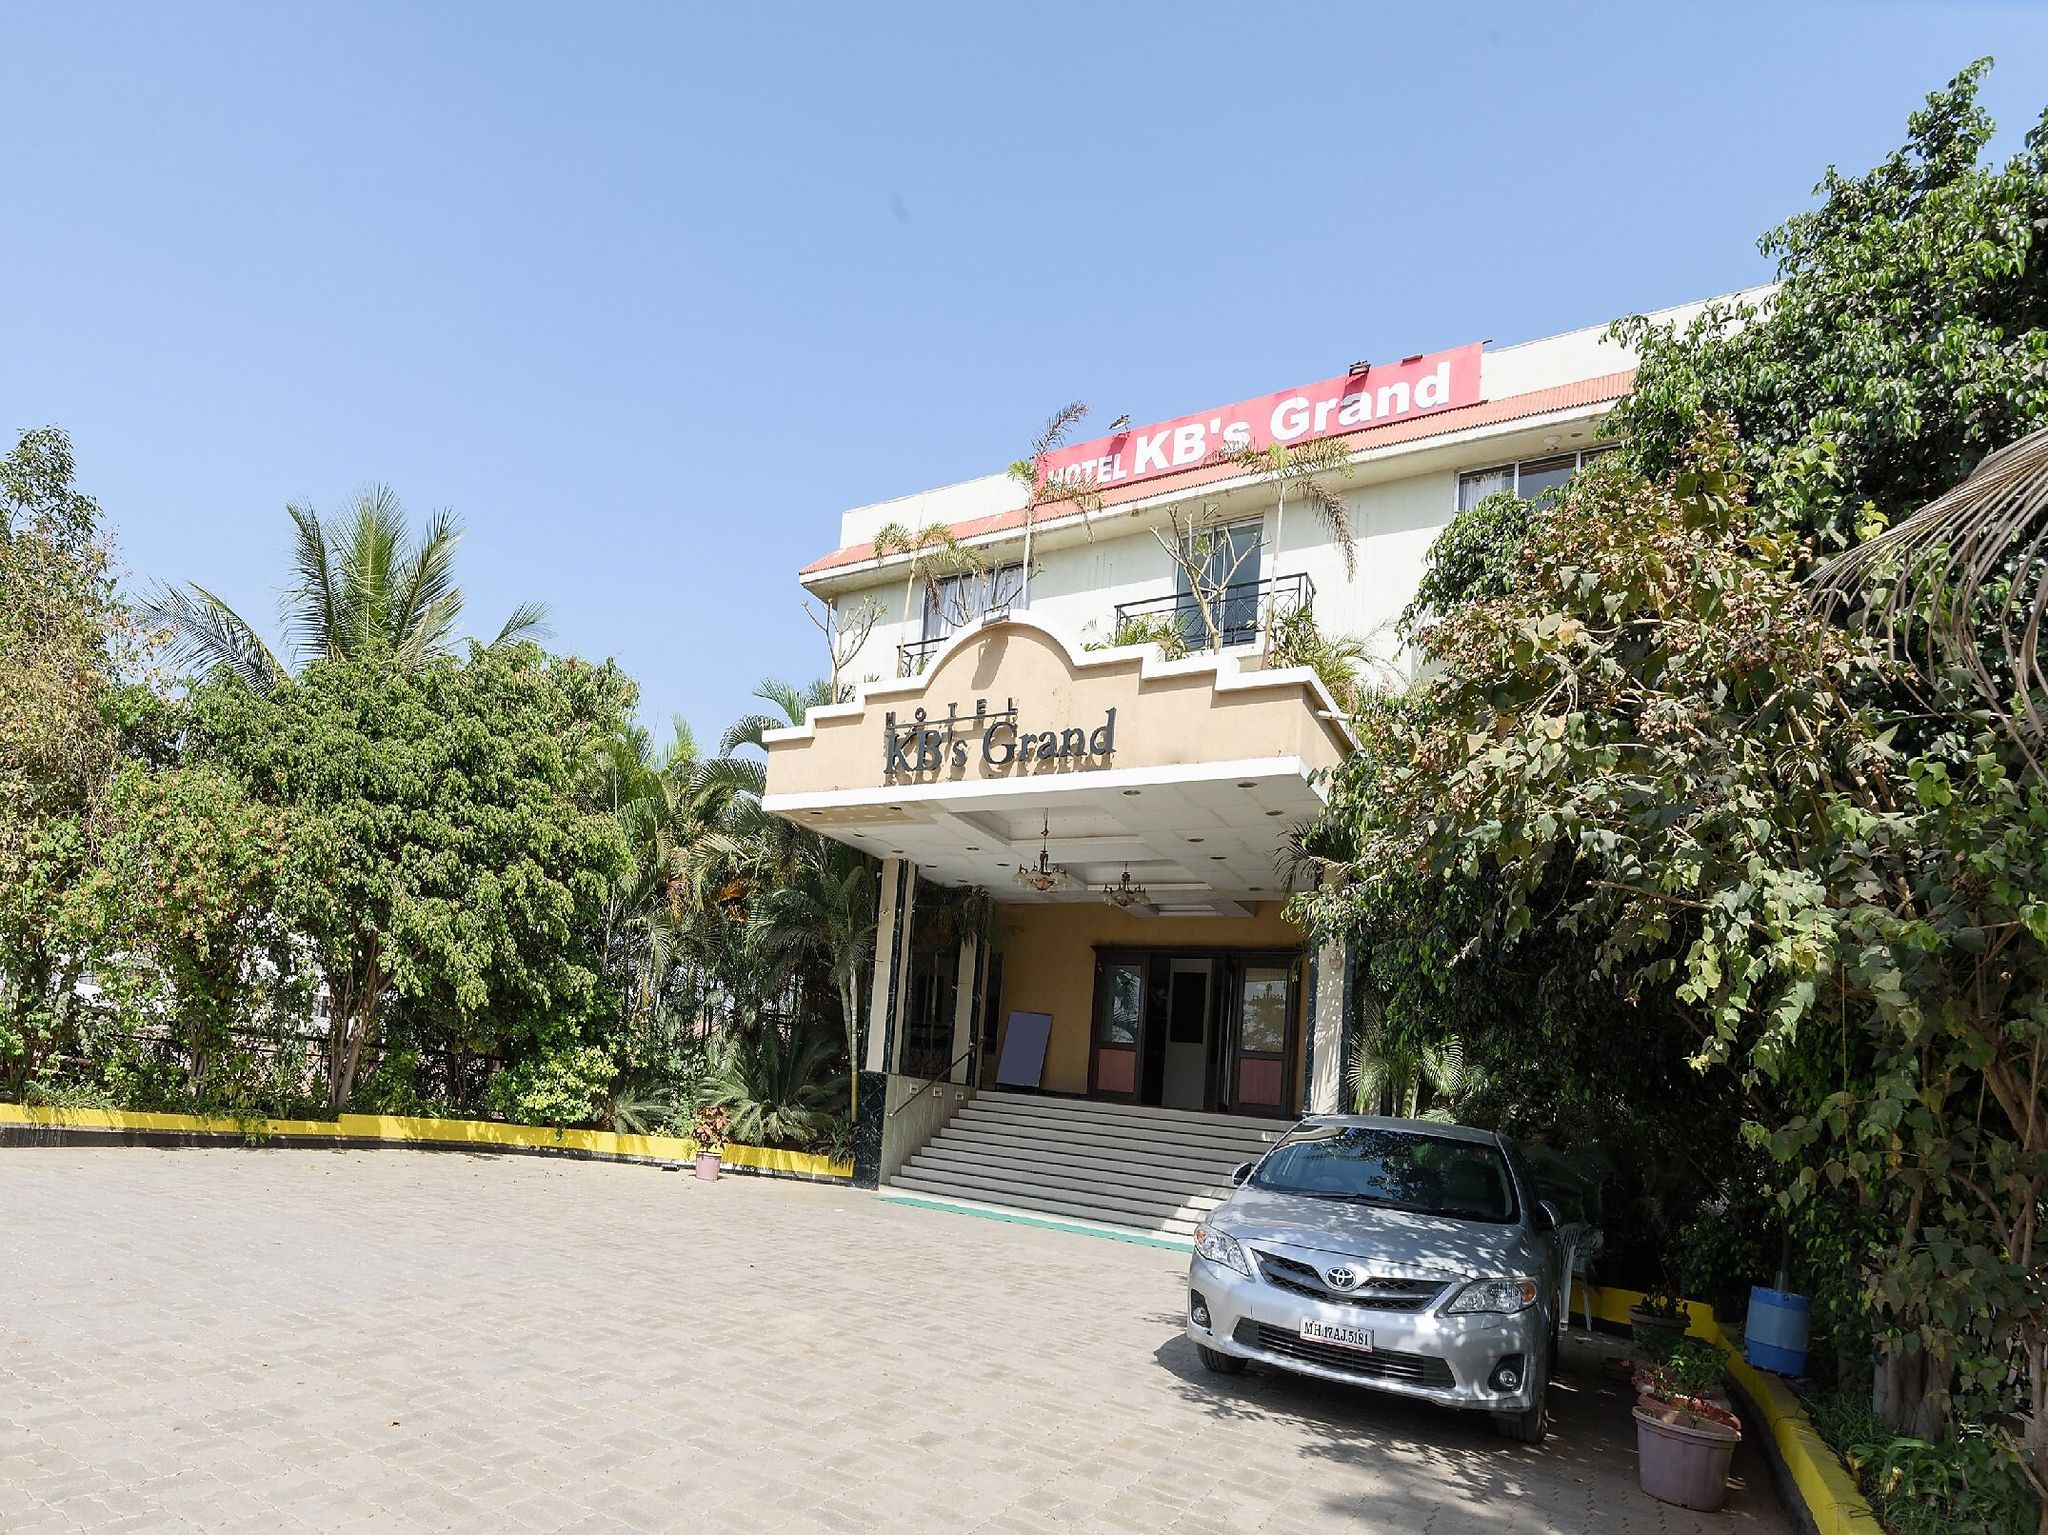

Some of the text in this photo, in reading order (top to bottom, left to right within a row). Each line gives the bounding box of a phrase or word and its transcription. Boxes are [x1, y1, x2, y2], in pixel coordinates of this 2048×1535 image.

[1047, 362, 1451, 489] HOTEL KB's Grand
[884, 707, 1117, 774] KB's Grand
[885, 698, 1018, 728] HOTEL
